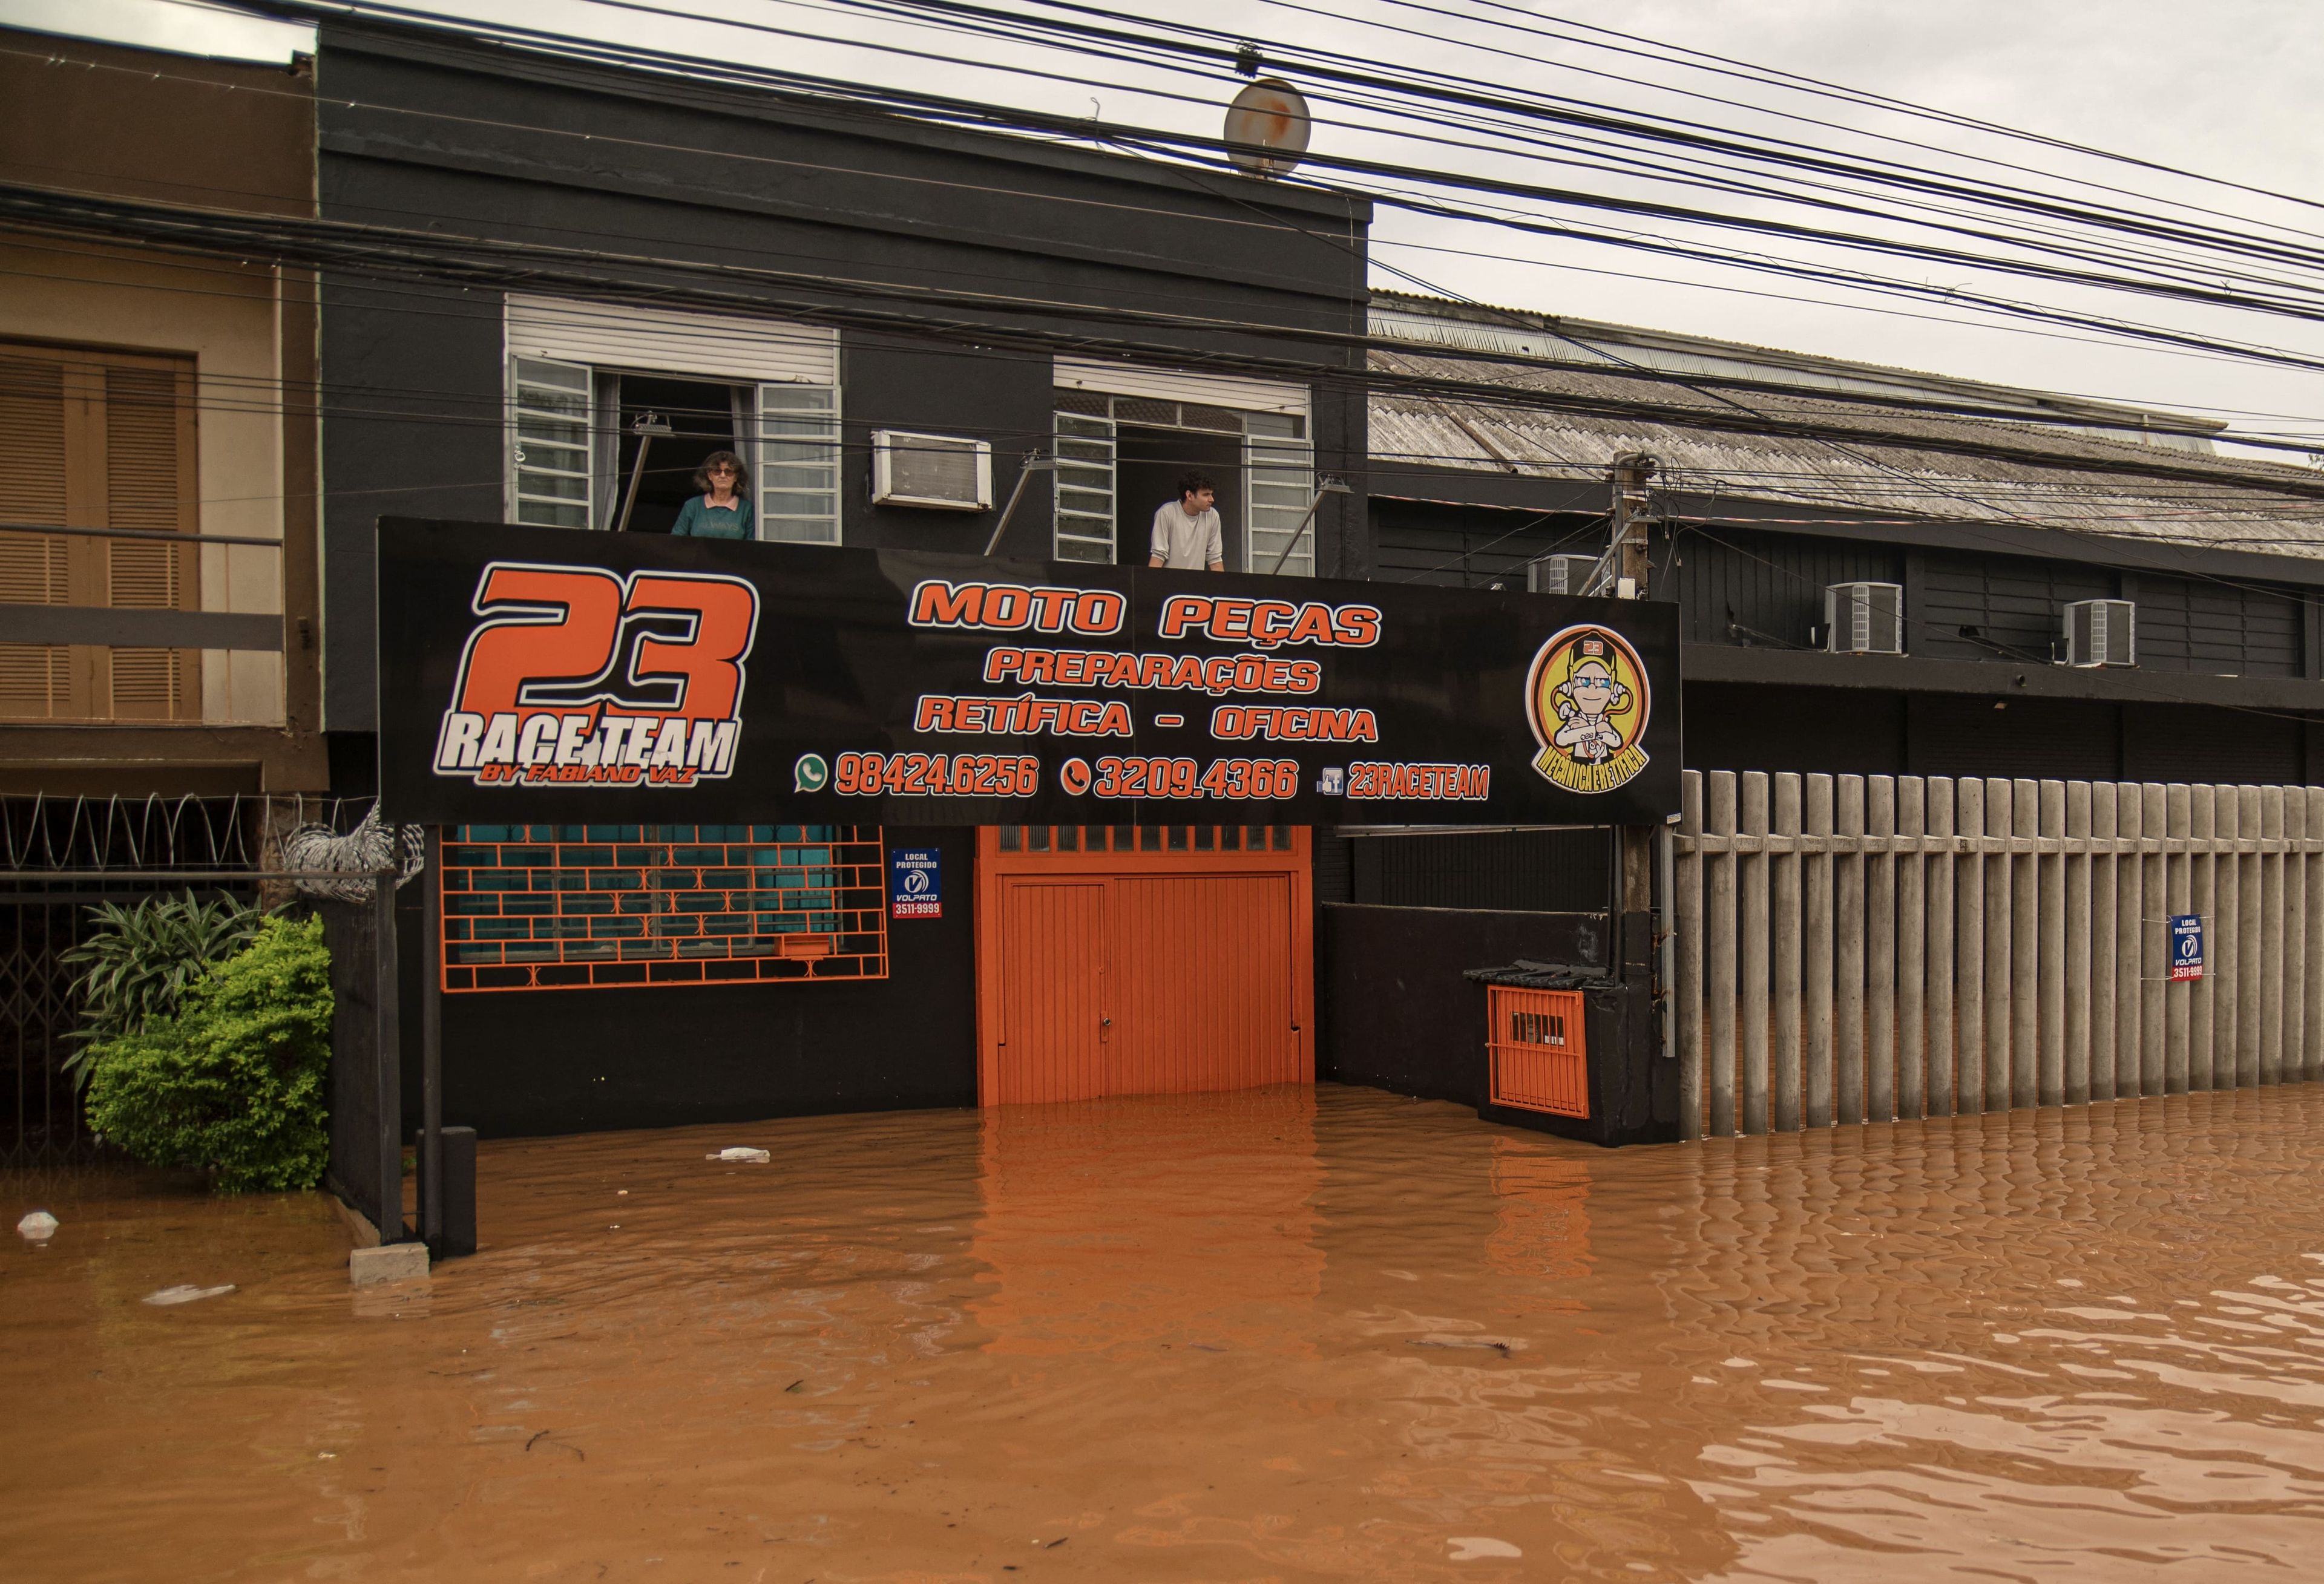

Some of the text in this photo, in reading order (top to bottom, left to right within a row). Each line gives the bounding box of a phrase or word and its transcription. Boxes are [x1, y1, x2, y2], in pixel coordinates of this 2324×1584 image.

[909, 581, 1382, 649] MOTO PEÇAS
[458, 561, 760, 739] 23
[1583, 640, 1603, 655] 23
[984, 647, 1321, 695] PREPARAÇÕES
[914, 692, 1378, 742] RETÍFICA - OFICINA
[435, 712, 740, 774] RACE TEAM
[478, 764, 700, 784] BY FABIANO VAZ
[835, 753, 1490, 800] 98424.6256 3209.4366 23RACETEAM
[1537, 745, 1592, 791] MECÂNICA
[1594, 765, 1600, 791] E
[896, 903, 939, 914] 3511-9999
[2174, 966, 2202, 977] 3511-9999
[2175, 957, 2201, 966] VOLPATO
